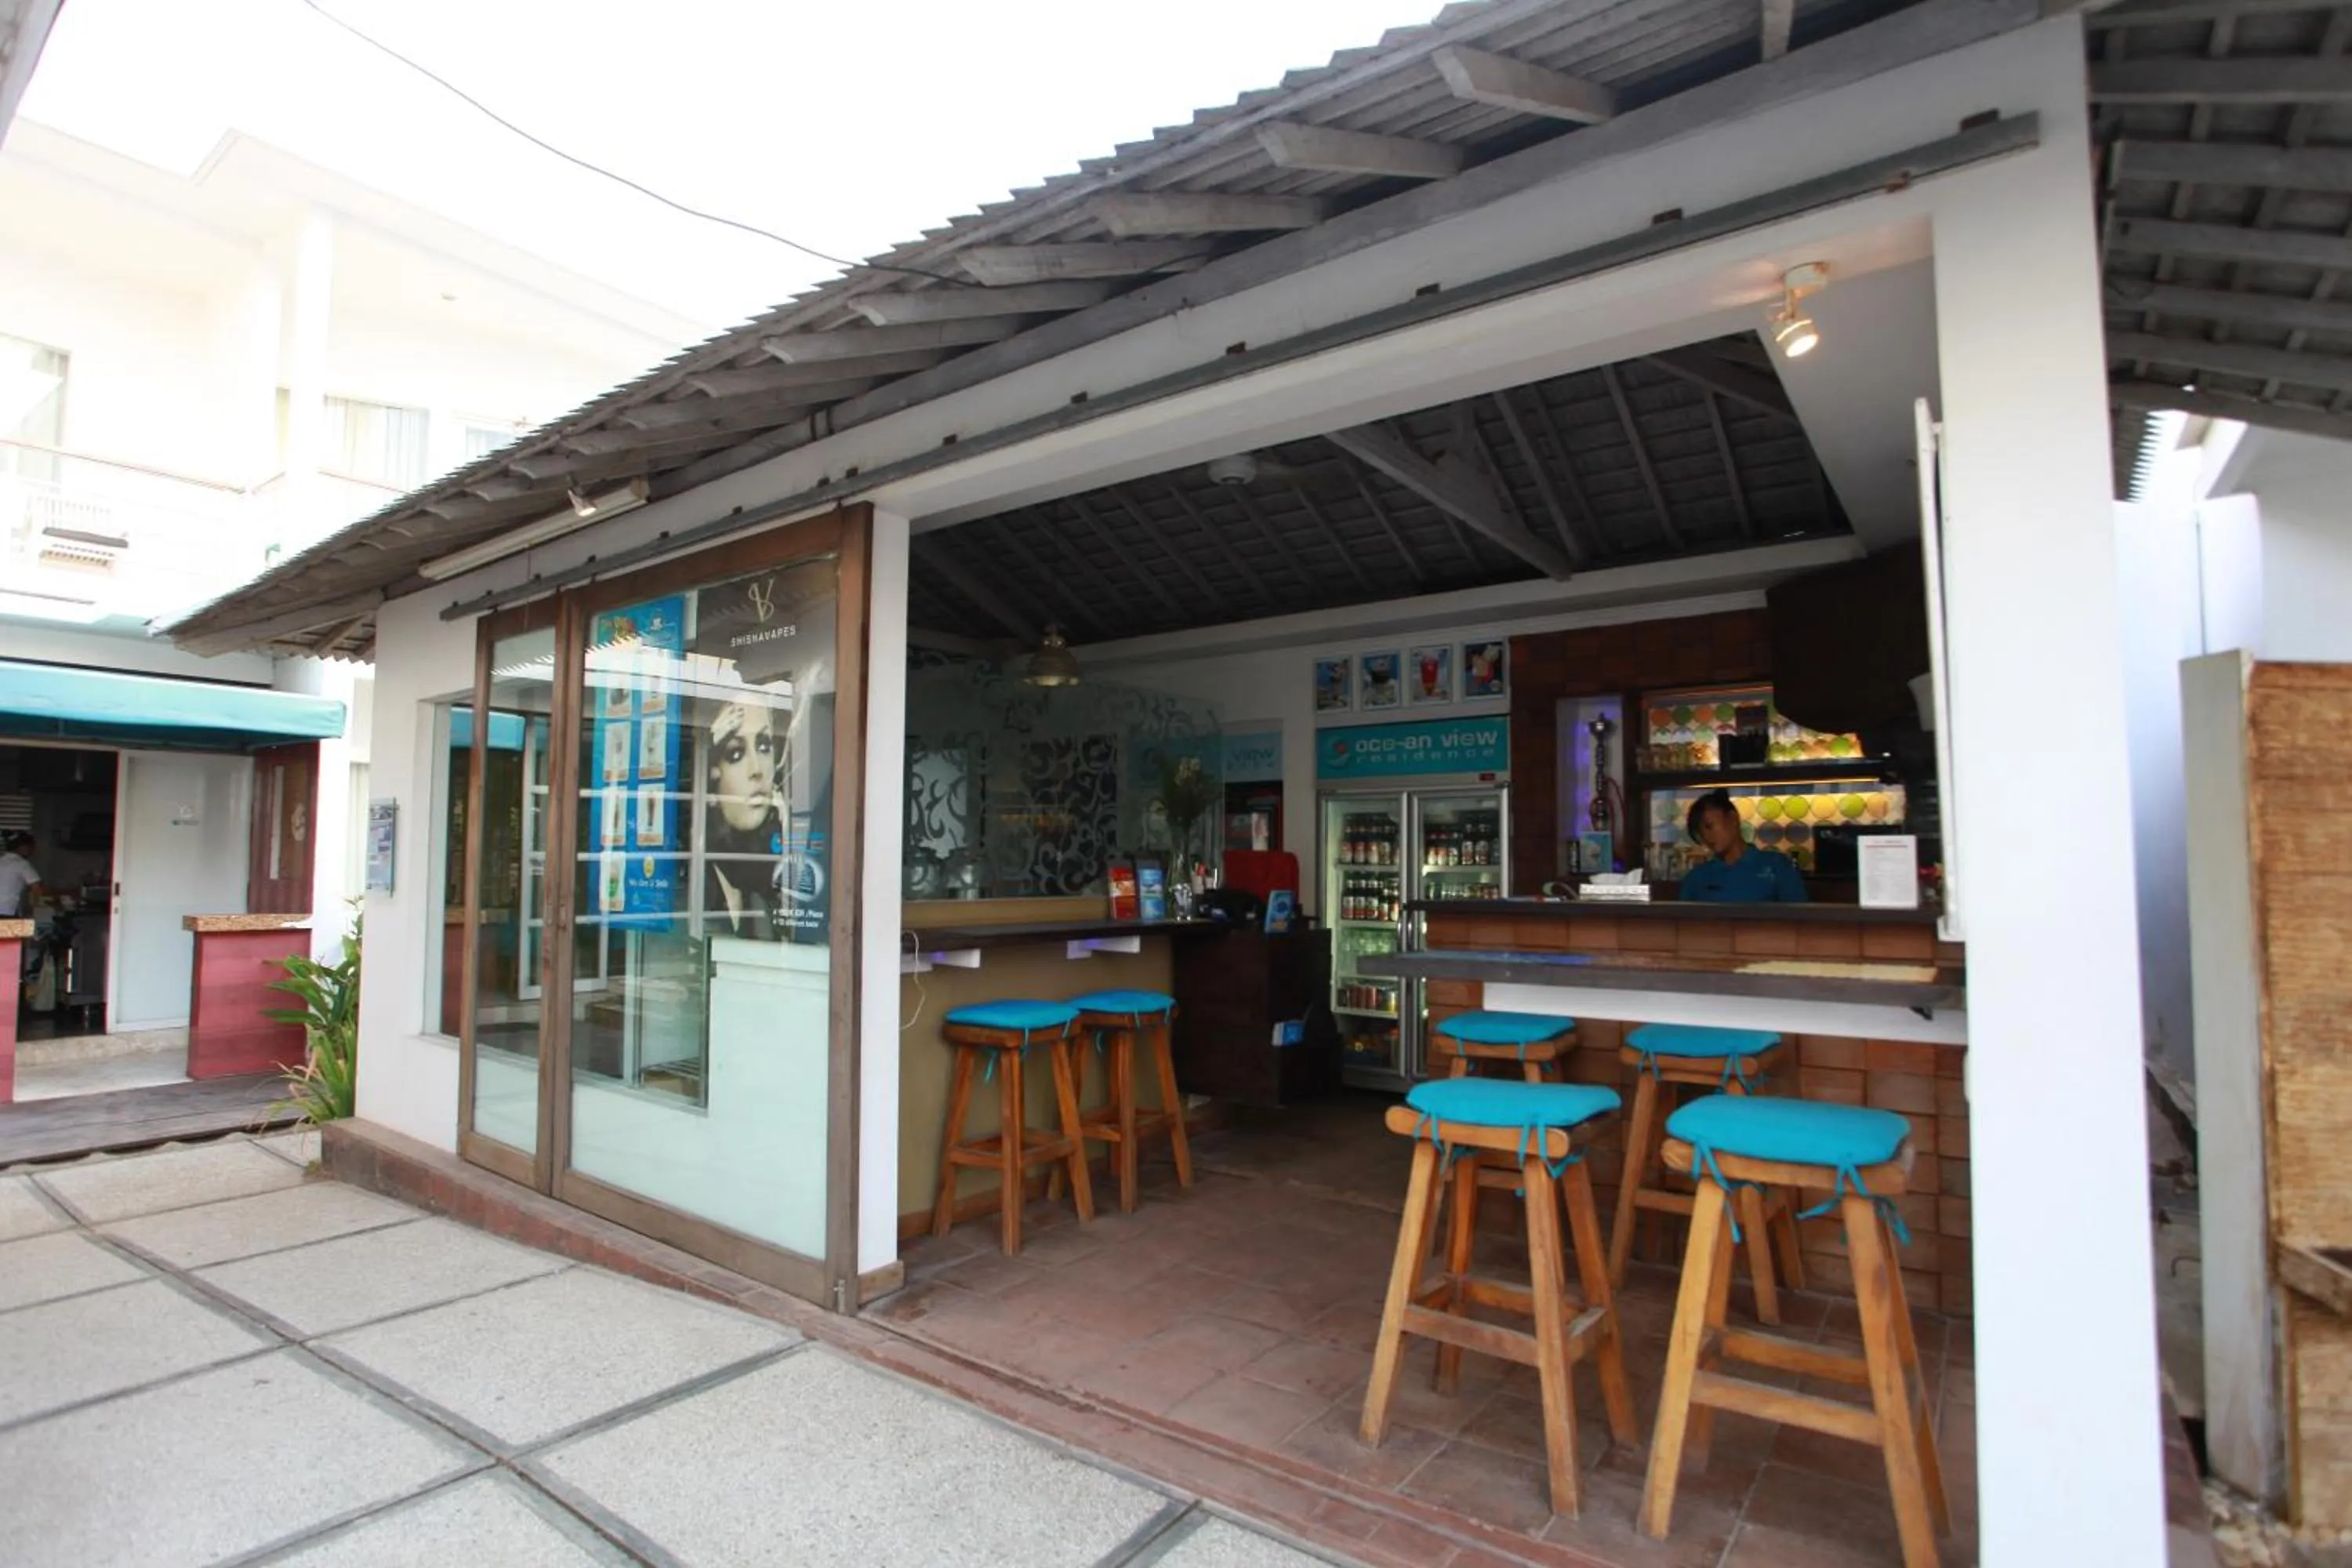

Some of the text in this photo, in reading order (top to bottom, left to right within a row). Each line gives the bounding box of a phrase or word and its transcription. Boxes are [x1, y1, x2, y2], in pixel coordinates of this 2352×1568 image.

[730, 625, 796, 647] SHISHAVAPES
[1440, 728, 1498, 748] view
[1356, 748, 1495, 764] residence
